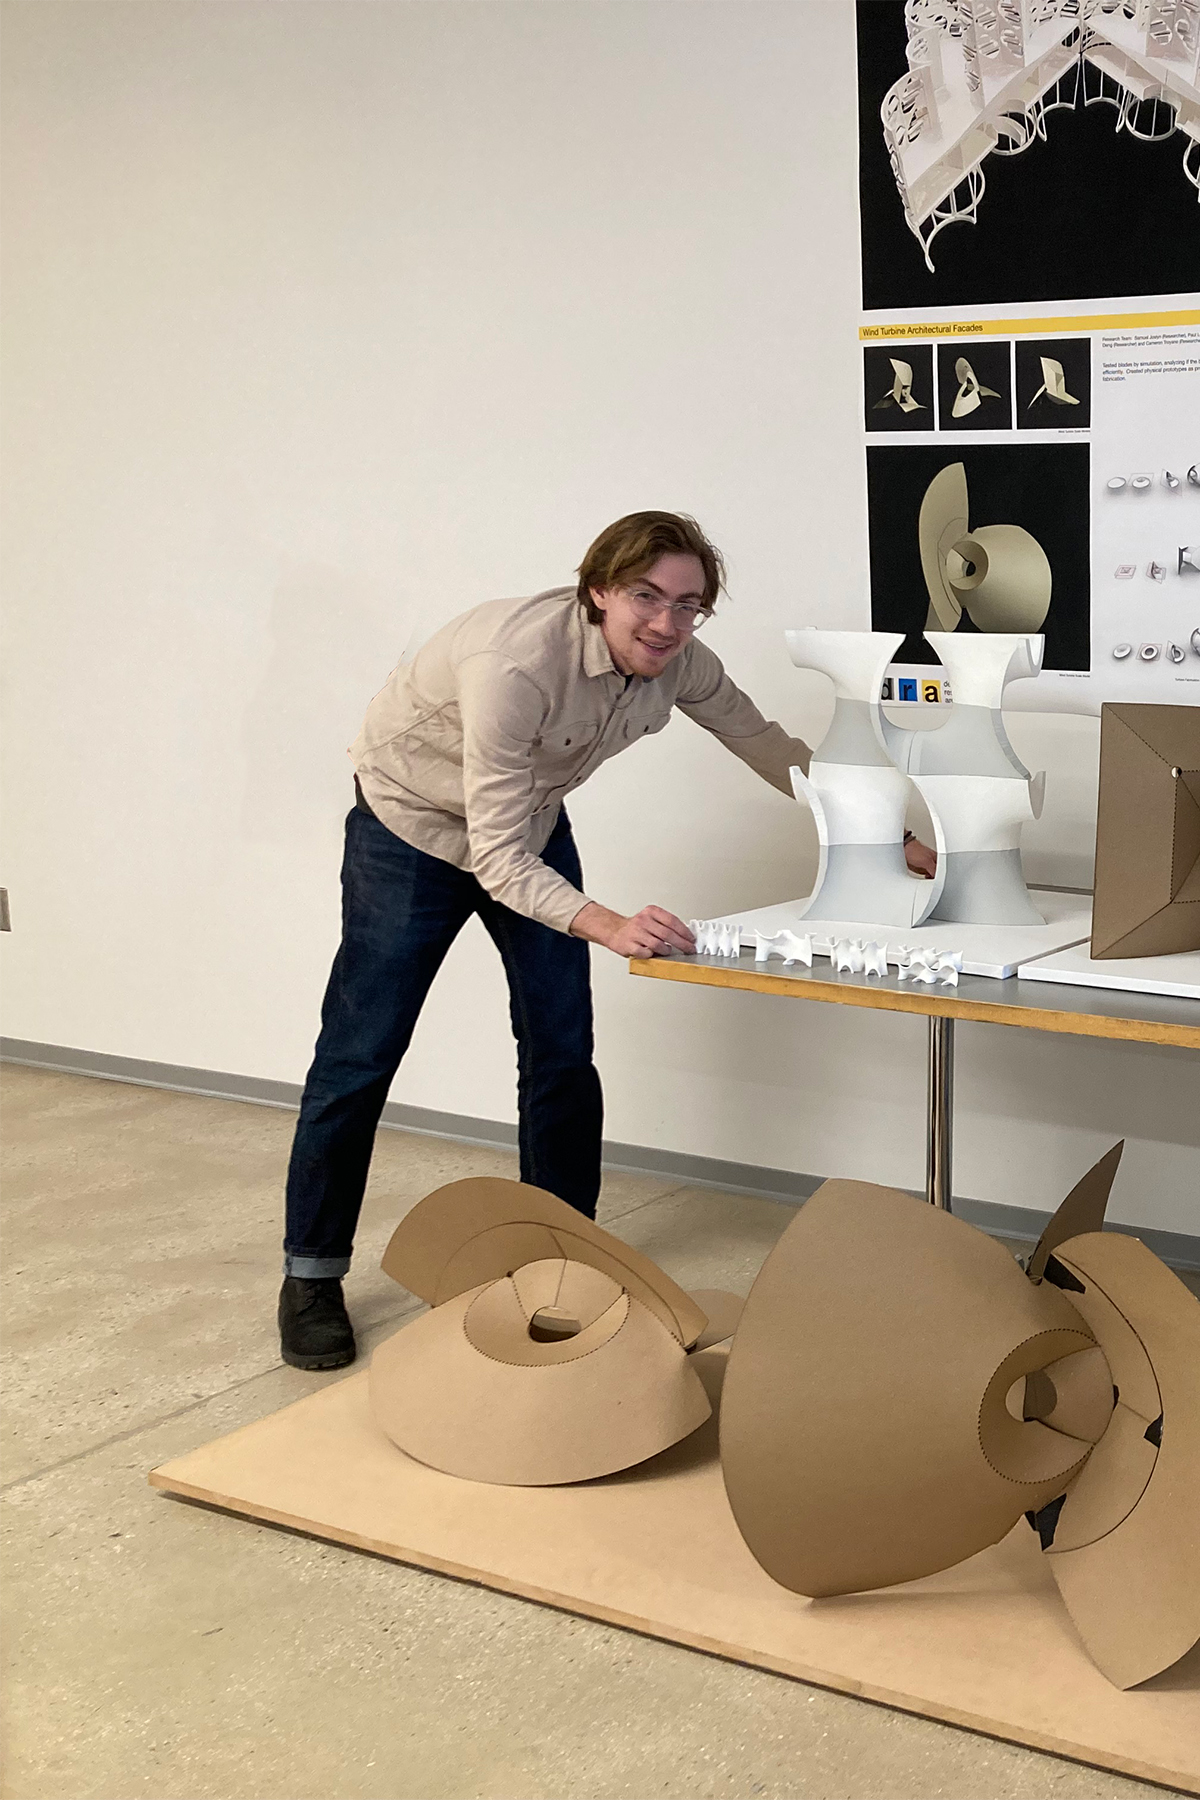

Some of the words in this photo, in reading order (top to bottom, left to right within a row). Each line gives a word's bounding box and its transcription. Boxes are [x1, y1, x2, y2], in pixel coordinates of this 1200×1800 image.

[863, 328, 879, 336] Wind
[881, 327, 905, 336] Turbine
[907, 325, 951, 334] Architectural
[953, 324, 983, 332] Facades
